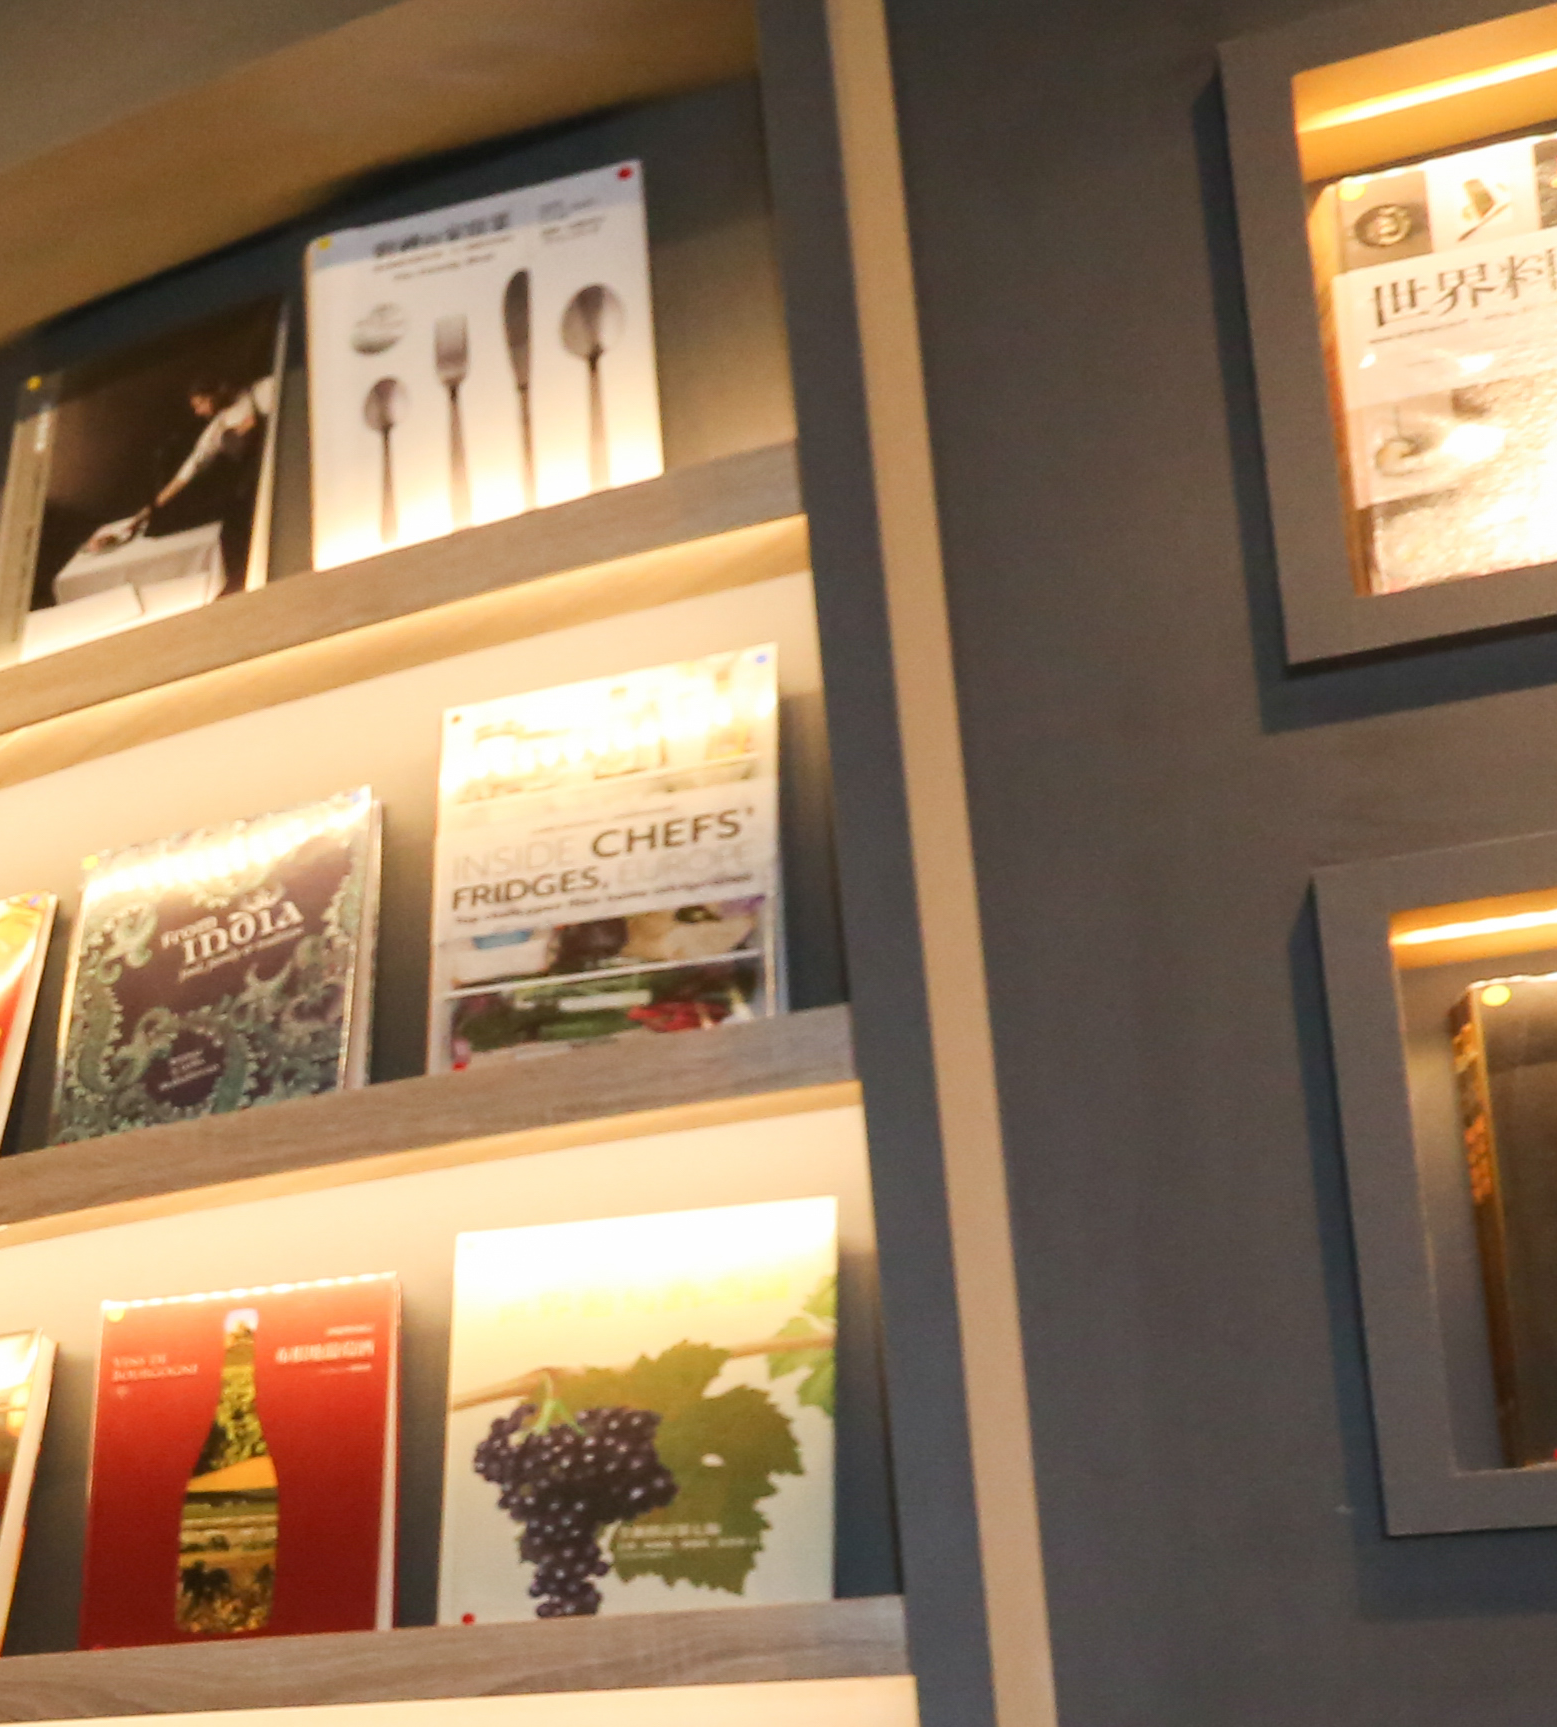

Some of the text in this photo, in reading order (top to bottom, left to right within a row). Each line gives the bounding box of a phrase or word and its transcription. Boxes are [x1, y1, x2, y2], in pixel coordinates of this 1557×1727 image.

[452, 838, 754, 911] FRIDGES, EUROPE
[453, 834, 575, 882] INSIDE
[592, 806, 755, 858] CHEFS'
